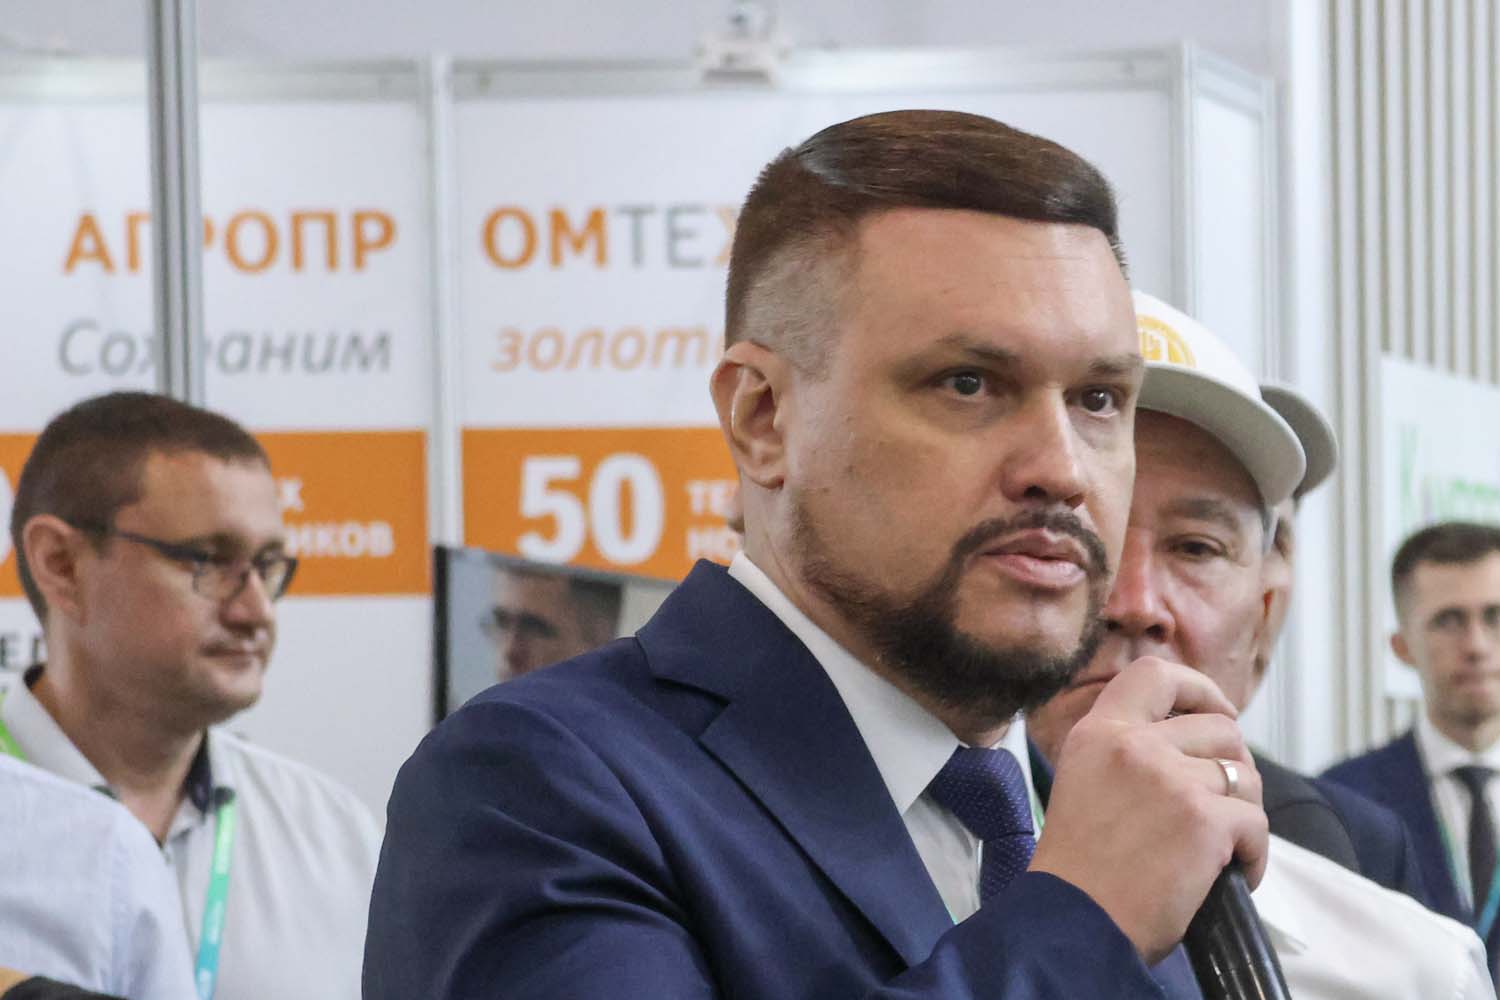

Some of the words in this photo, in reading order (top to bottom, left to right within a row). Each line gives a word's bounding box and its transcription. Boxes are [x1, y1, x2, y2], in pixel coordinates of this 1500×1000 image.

[57, 317, 394, 377] Соаним
[490, 325, 725, 374] золот
[517, 452, 666, 566] 50
[285, 522, 395, 557] ИКОВ
